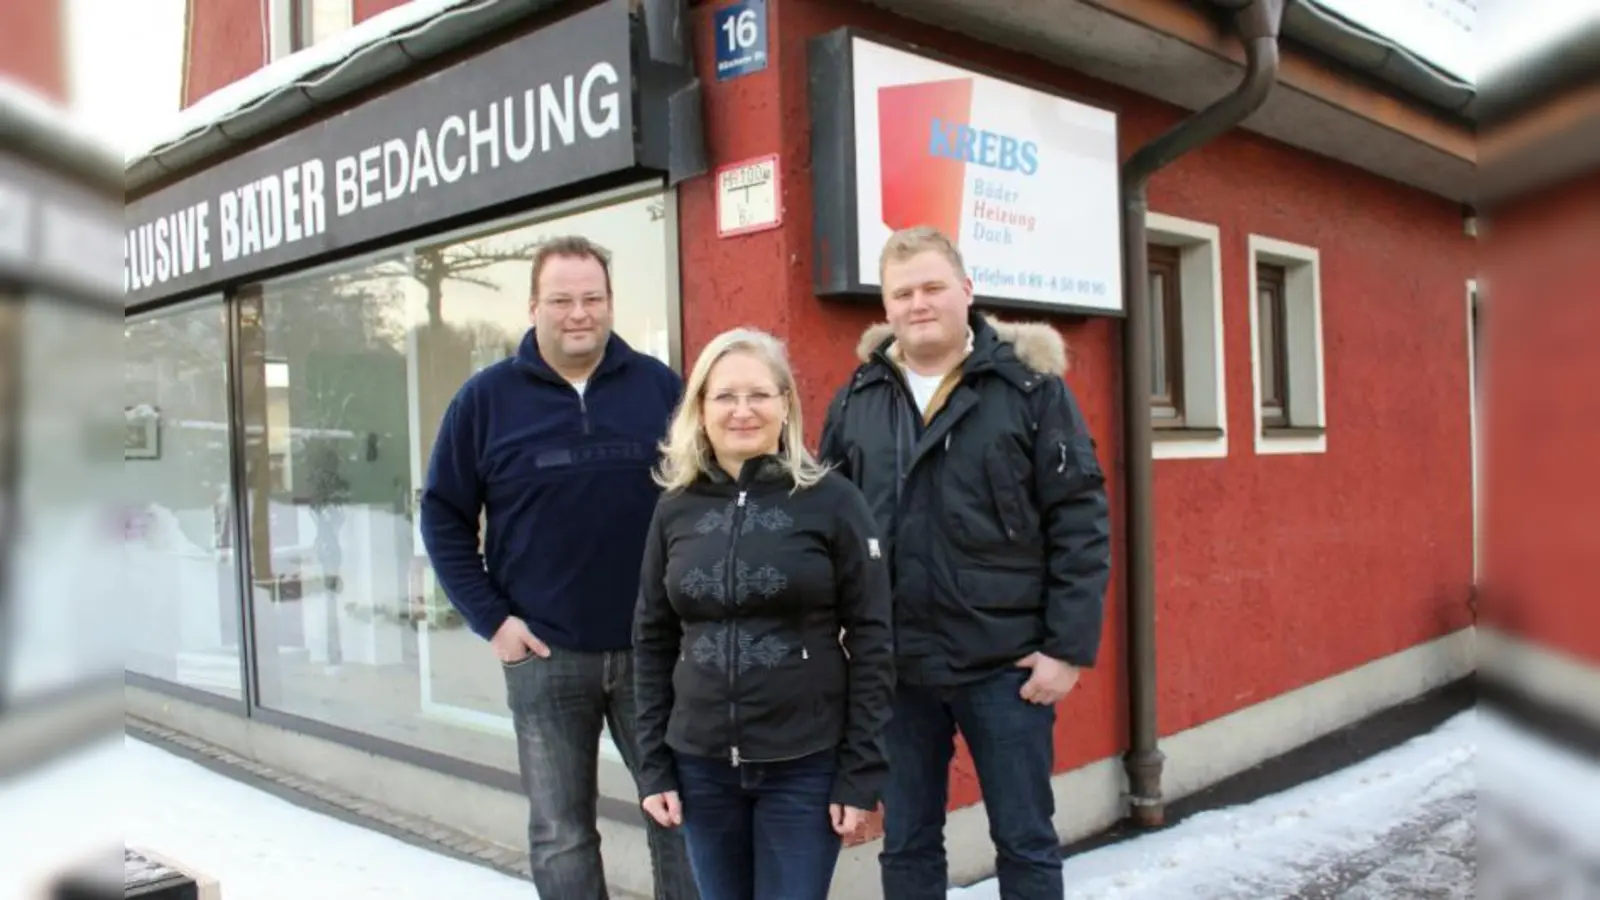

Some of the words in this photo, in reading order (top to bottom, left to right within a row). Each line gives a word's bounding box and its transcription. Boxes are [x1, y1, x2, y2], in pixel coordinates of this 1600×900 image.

[722, 9, 757, 52] 16
[930, 119, 1038, 175] KREBS
[125, 201, 211, 293] LUSIVE
[220, 158, 326, 262] BÄDER
[335, 62, 620, 217] BEDACHUNG
[974, 178, 1019, 204] Bäder
[973, 199, 1037, 232] Heizung
[973, 221, 1013, 245] Dach
[971, 266, 1015, 289] Telefon
